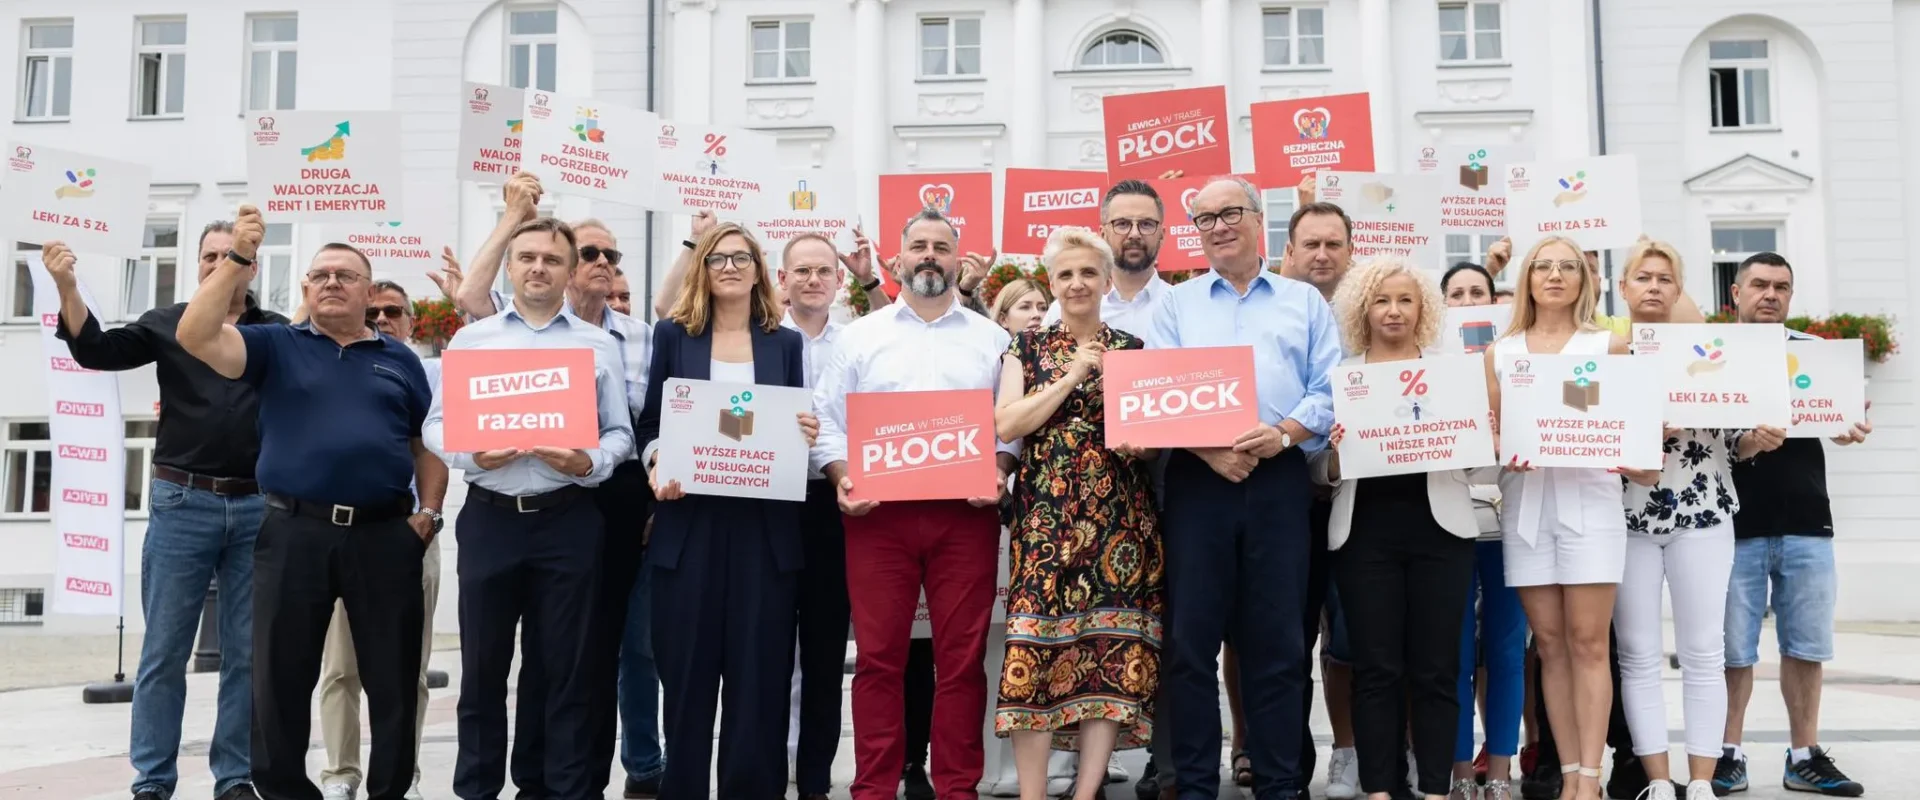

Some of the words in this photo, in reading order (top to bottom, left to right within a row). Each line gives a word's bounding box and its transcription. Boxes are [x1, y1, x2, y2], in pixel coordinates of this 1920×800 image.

[1128, 118, 1161, 132] LEWICA
[1162, 115, 1172, 124] W
[1173, 108, 1202, 121] TRASIE
[1118, 120, 1217, 162] PŁOCK
[1283, 140, 1346, 154] BEZPIECZNA
[562, 144, 610, 162] ZASIŁEK
[1292, 153, 1338, 166] RODZINA
[301, 168, 351, 180] DRUGA
[472, 160, 502, 174] RENT
[540, 154, 628, 180] POGRZEBOWY
[560, 172, 591, 186] 7000
[593, 177, 608, 190] ZŁ
[662, 172, 698, 184] WALKA
[700, 176, 706, 185] Z
[708, 176, 760, 192] DROŻYZNĄ
[273, 184, 380, 196] WALORYZACJA
[684, 186, 716, 198] NIŻSZE
[718, 190, 744, 200] RATY
[268, 200, 302, 212] RENT
[306, 200, 310, 211] I
[314, 199, 386, 211] EMERYTUR
[683, 196, 738, 211] KREDYTÓW
[1028, 191, 1095, 208] LEWICA
[1442, 208, 1452, 216] W
[1454, 208, 1504, 217] USŁUGACH
[33, 210, 60, 224] LEKI
[62, 215, 80, 228] ZA
[84, 219, 92, 229] 5
[94, 221, 109, 232] ZŁ
[824, 220, 846, 228] BON
[1350, 221, 1415, 232] ODNIESIENIE
[1441, 218, 1504, 228] PUBLICZNYCH
[1538, 221, 1562, 232] LEKI
[1565, 220, 1581, 230] ZA
[1584, 220, 1590, 228] 5
[1594, 218, 1608, 228] ZŁ
[348, 233, 397, 244] OBNIŻKA
[400, 236, 422, 245] CEN
[1350, 234, 1392, 244] MALNEJ
[1394, 236, 1429, 246] RENTY
[390, 249, 431, 258] PALIWA
[475, 372, 565, 396] LEWICA
[1132, 376, 1174, 389] LEWICA
[1176, 373, 1187, 382] W
[1188, 368, 1224, 382] TRASIE
[1120, 381, 1242, 421] PŁOCK
[1668, 392, 1696, 403] LEKI
[1700, 392, 1718, 404] ZA
[1722, 393, 1730, 403] 5
[1734, 393, 1749, 404] ZŁ
[1808, 398, 1832, 408] CEN
[478, 410, 565, 430] razem
[1536, 417, 1584, 429] WYŻSZE
[1587, 420, 1626, 430] PŁACE
[1798, 413, 1844, 422] PALIWA
[875, 422, 915, 436] LEWICA
[917, 420, 928, 430] W
[930, 414, 965, 428] TRASIE
[1358, 426, 1400, 440] WALKA
[1403, 425, 1411, 434] Z
[1413, 418, 1478, 434] DROŻYZNĄ
[1380, 442, 1384, 452] I
[1386, 438, 1424, 451] NIŻSZE
[1428, 435, 1456, 448] RATY
[1540, 432, 1552, 442] W
[1556, 433, 1621, 444] USŁUGACH
[693, 445, 738, 458] WYŻSZE
[740, 449, 776, 461] PŁACE
[862, 428, 980, 472] PŁOCK
[1388, 448, 1452, 464] KREDYTÓW
[1540, 446, 1621, 457] PUBLICZNYCH
[695, 460, 708, 470] W
[710, 461, 770, 474] USŁUGACH
[693, 473, 770, 488] PUBLICZNYCH
